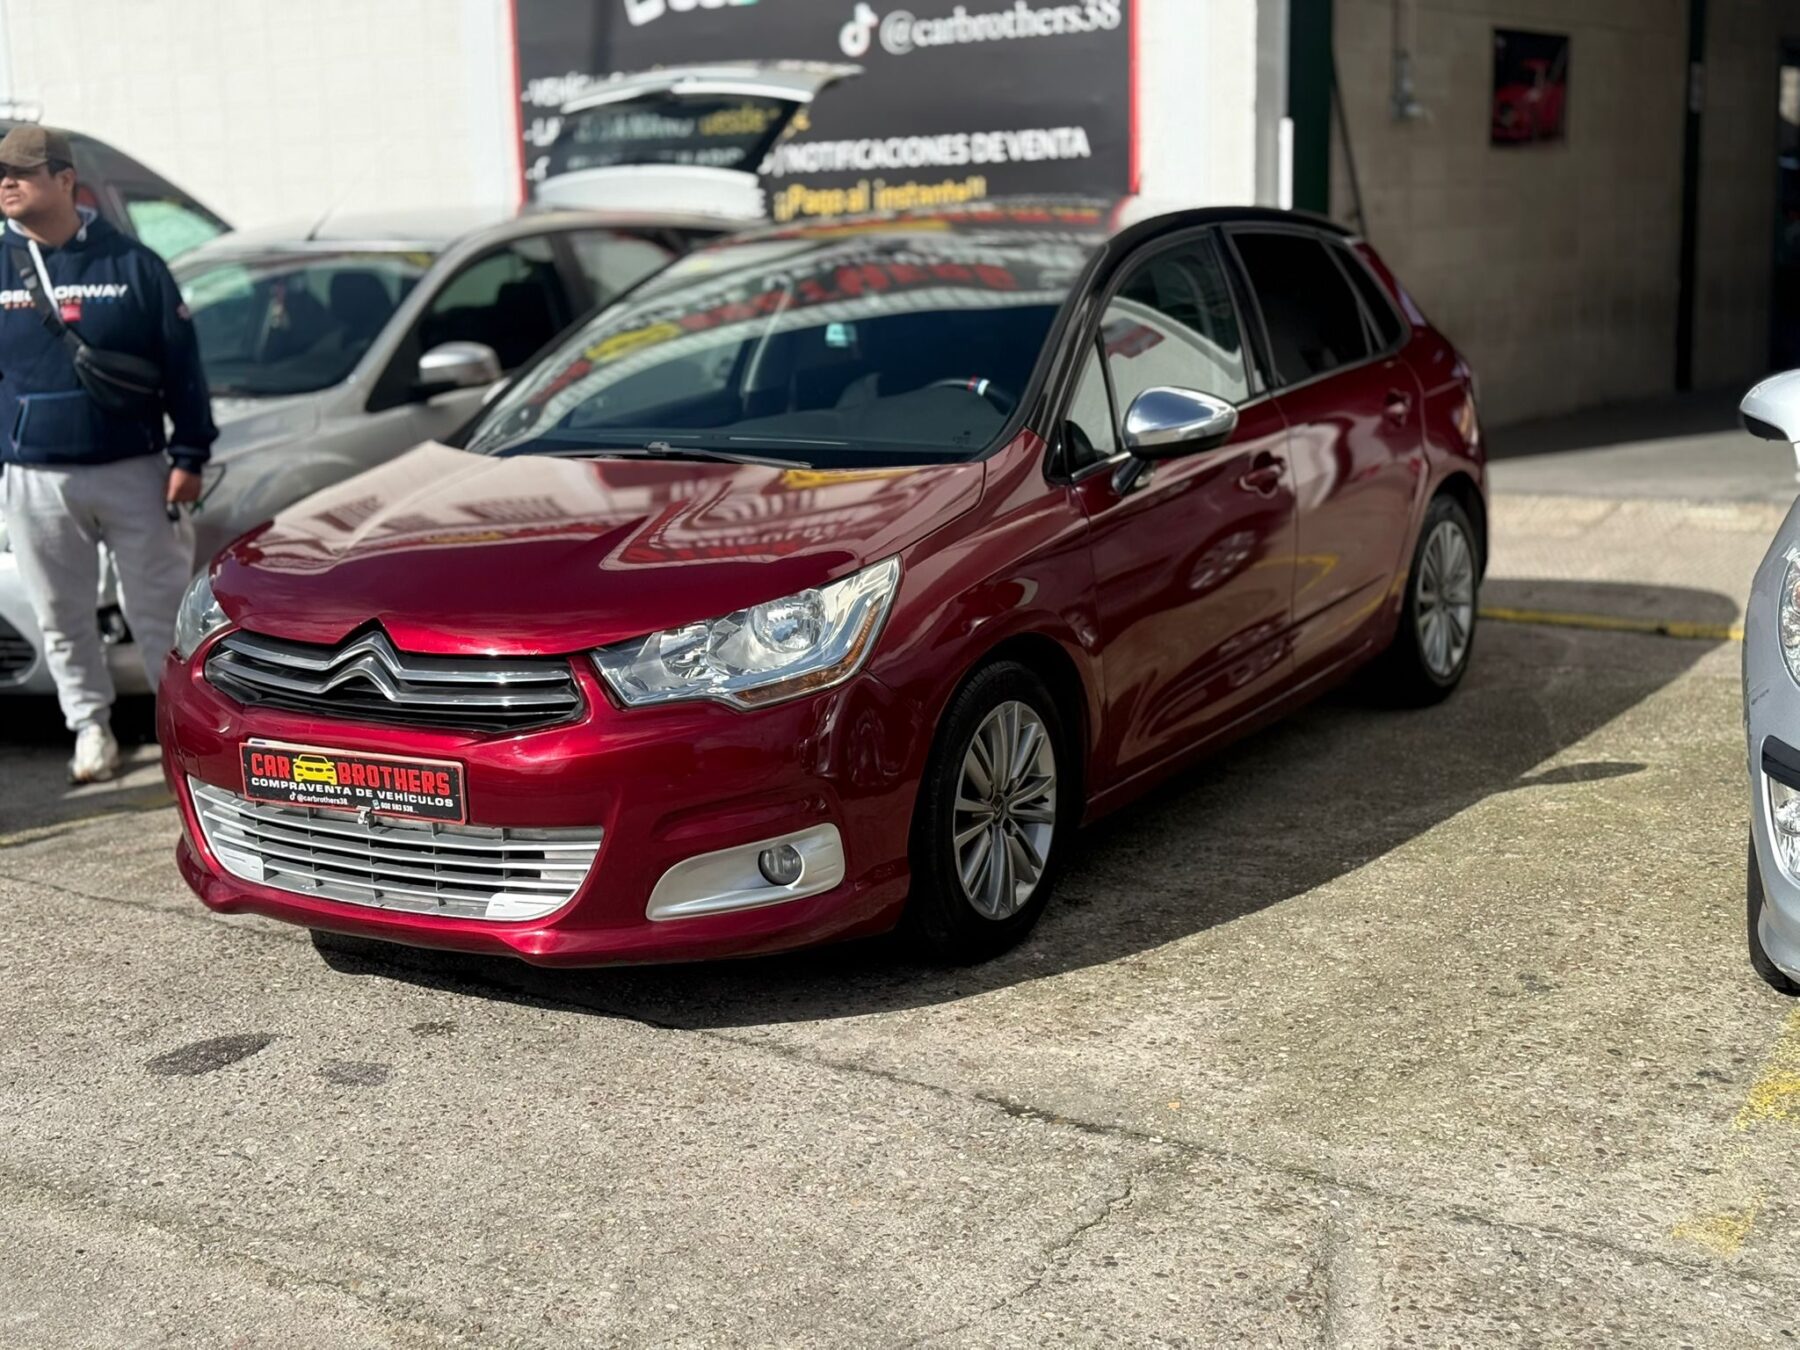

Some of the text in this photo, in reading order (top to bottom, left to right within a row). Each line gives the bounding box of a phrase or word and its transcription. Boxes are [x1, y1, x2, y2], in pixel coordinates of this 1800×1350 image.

[1002, 126, 1092, 161] VENTA
[53, 284, 128, 300] ORWAY
[251, 753, 451, 796] CAR BROTHERS
[251, 777, 454, 808] COMPRAVENTA DE VEHÍCULOS
